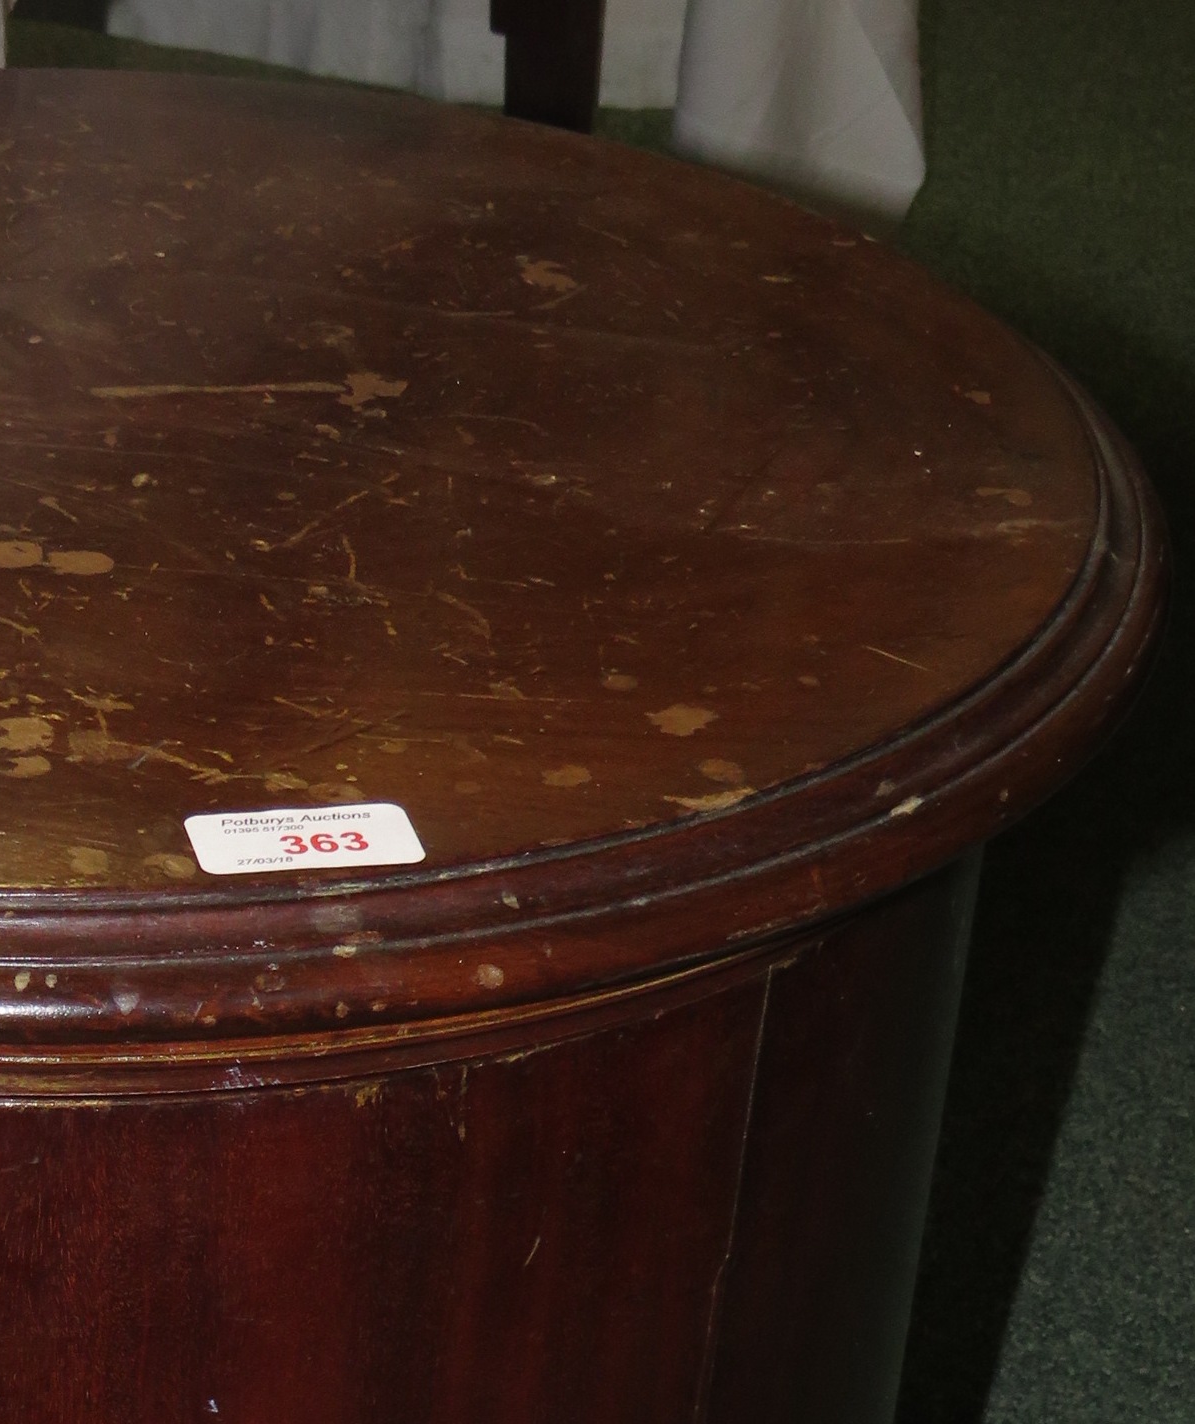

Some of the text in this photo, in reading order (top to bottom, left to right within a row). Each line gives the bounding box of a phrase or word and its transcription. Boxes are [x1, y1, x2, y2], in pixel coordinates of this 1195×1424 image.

[221, 811, 371, 827] Potburys Auctions
[279, 832, 369, 855] 363
[236, 856, 293, 866] 27/03/18
